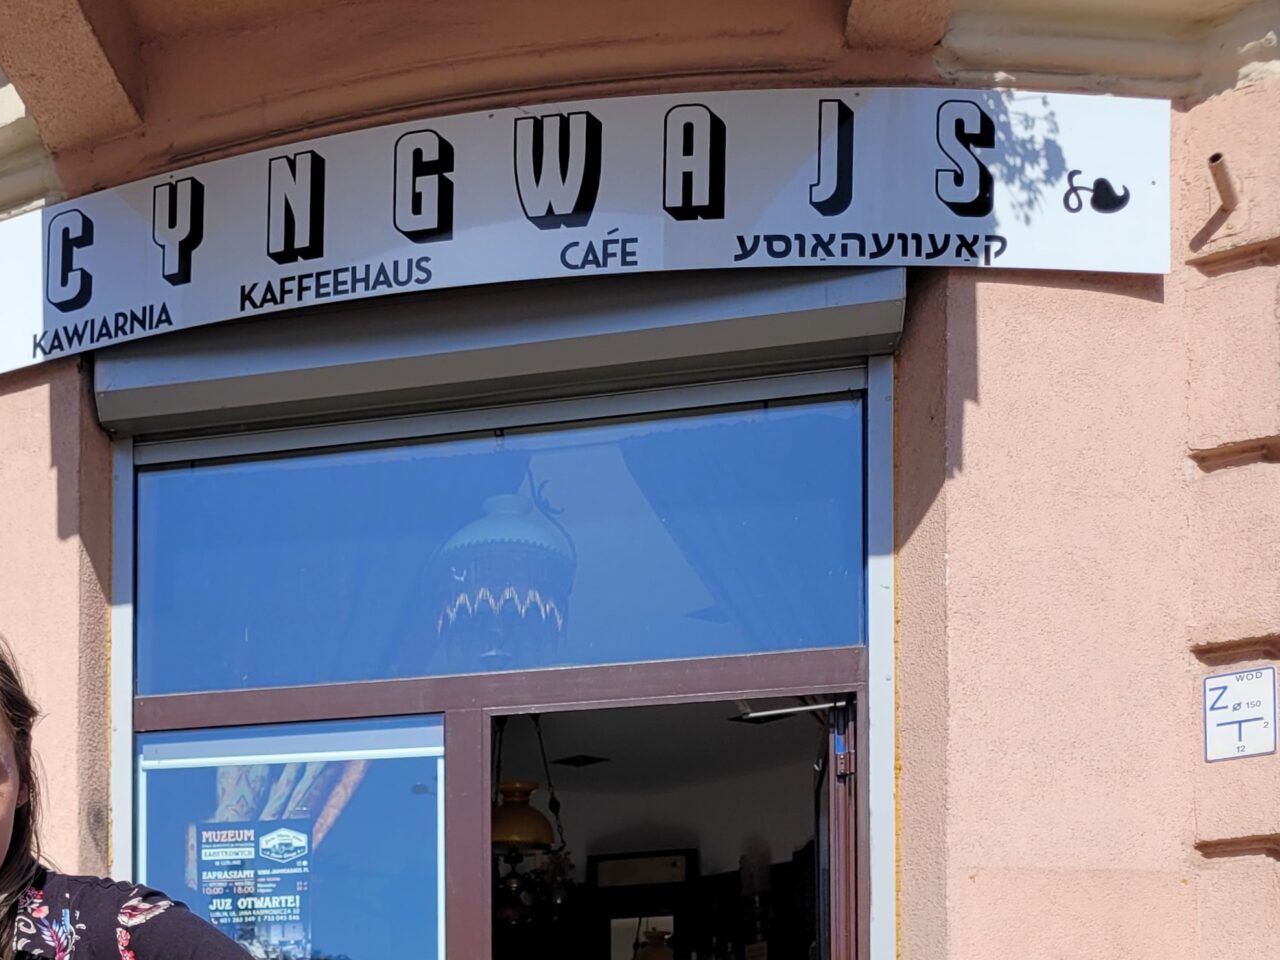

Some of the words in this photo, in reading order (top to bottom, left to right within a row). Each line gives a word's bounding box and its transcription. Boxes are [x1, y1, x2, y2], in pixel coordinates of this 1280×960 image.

[46, 97, 995, 313] CYNGWAJS
[560, 228, 639, 270] CAFÉ
[239, 256, 433, 311] KAFFEEHAUS
[31, 301, 173, 359] KAWIARNIA
[1235, 671, 1263, 682] WOD
[1208, 685, 1229, 711] Z
[1245, 700, 1262, 709] 150
[1263, 721, 1270, 729] 2
[1236, 745, 1246, 753] 12
[201, 830, 255, 843] MUZEUM
